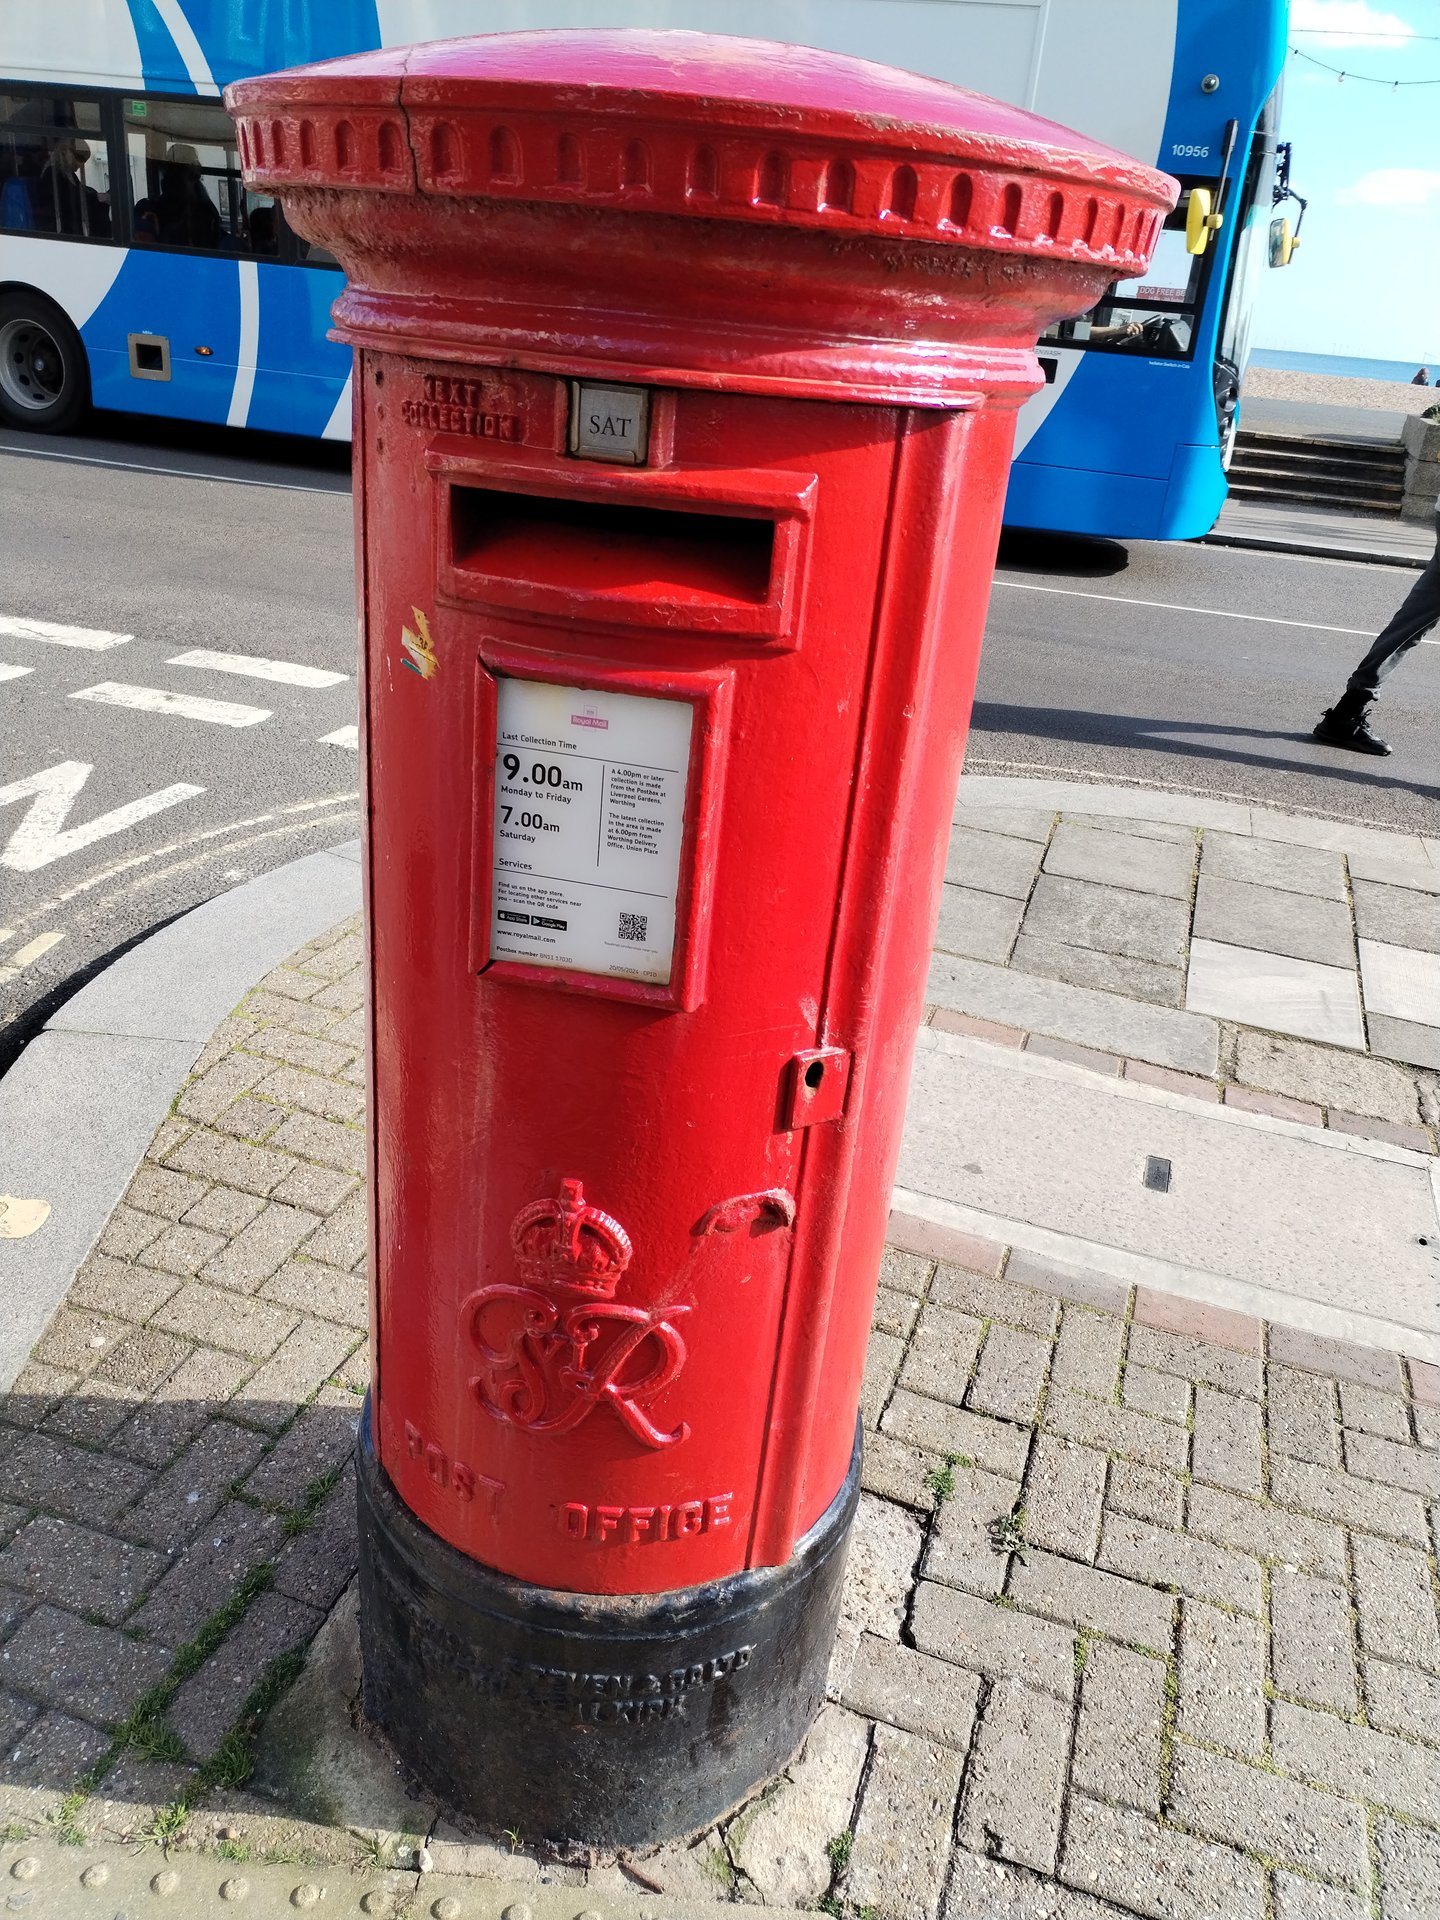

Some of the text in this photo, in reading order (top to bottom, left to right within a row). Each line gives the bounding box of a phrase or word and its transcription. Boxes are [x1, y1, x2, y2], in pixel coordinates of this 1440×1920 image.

[1172, 144, 1210, 158] 10956
[1139, 286, 1155, 294] DOG
[1156, 288, 1175, 296] FREE
[589, 414, 632, 438] SAT
[572, 716, 608, 728] Royal Mail
[502, 731, 577, 750] Last Collection Time
[503, 753, 583, 792] 9.00am
[611, 777, 638, 785] collection
[501, 785, 572, 805] Monday to Friday
[610, 791, 637, 800] Liverpool
[636, 788, 659, 796] Postbox
[609, 798, 636, 808] Worthing
[500, 805, 561, 833] 7.00am
[638, 817, 665, 826] collection
[499, 829, 536, 843] Saturday
[607, 835, 657, 849] Worthing Delivery
[643, 847, 659, 855] Place
[499, 857, 533, 870] Services
[508, 890, 530, 899] locating
[530, 893, 546, 901] other
[546, 896, 569, 905] services
[497, 929, 556, 944] www.royalmail.com
[496, 945, 517, 954] Postbox
[517, 950, 539, 958] number
[404, 1418, 734, 1542] POST OFFICE
